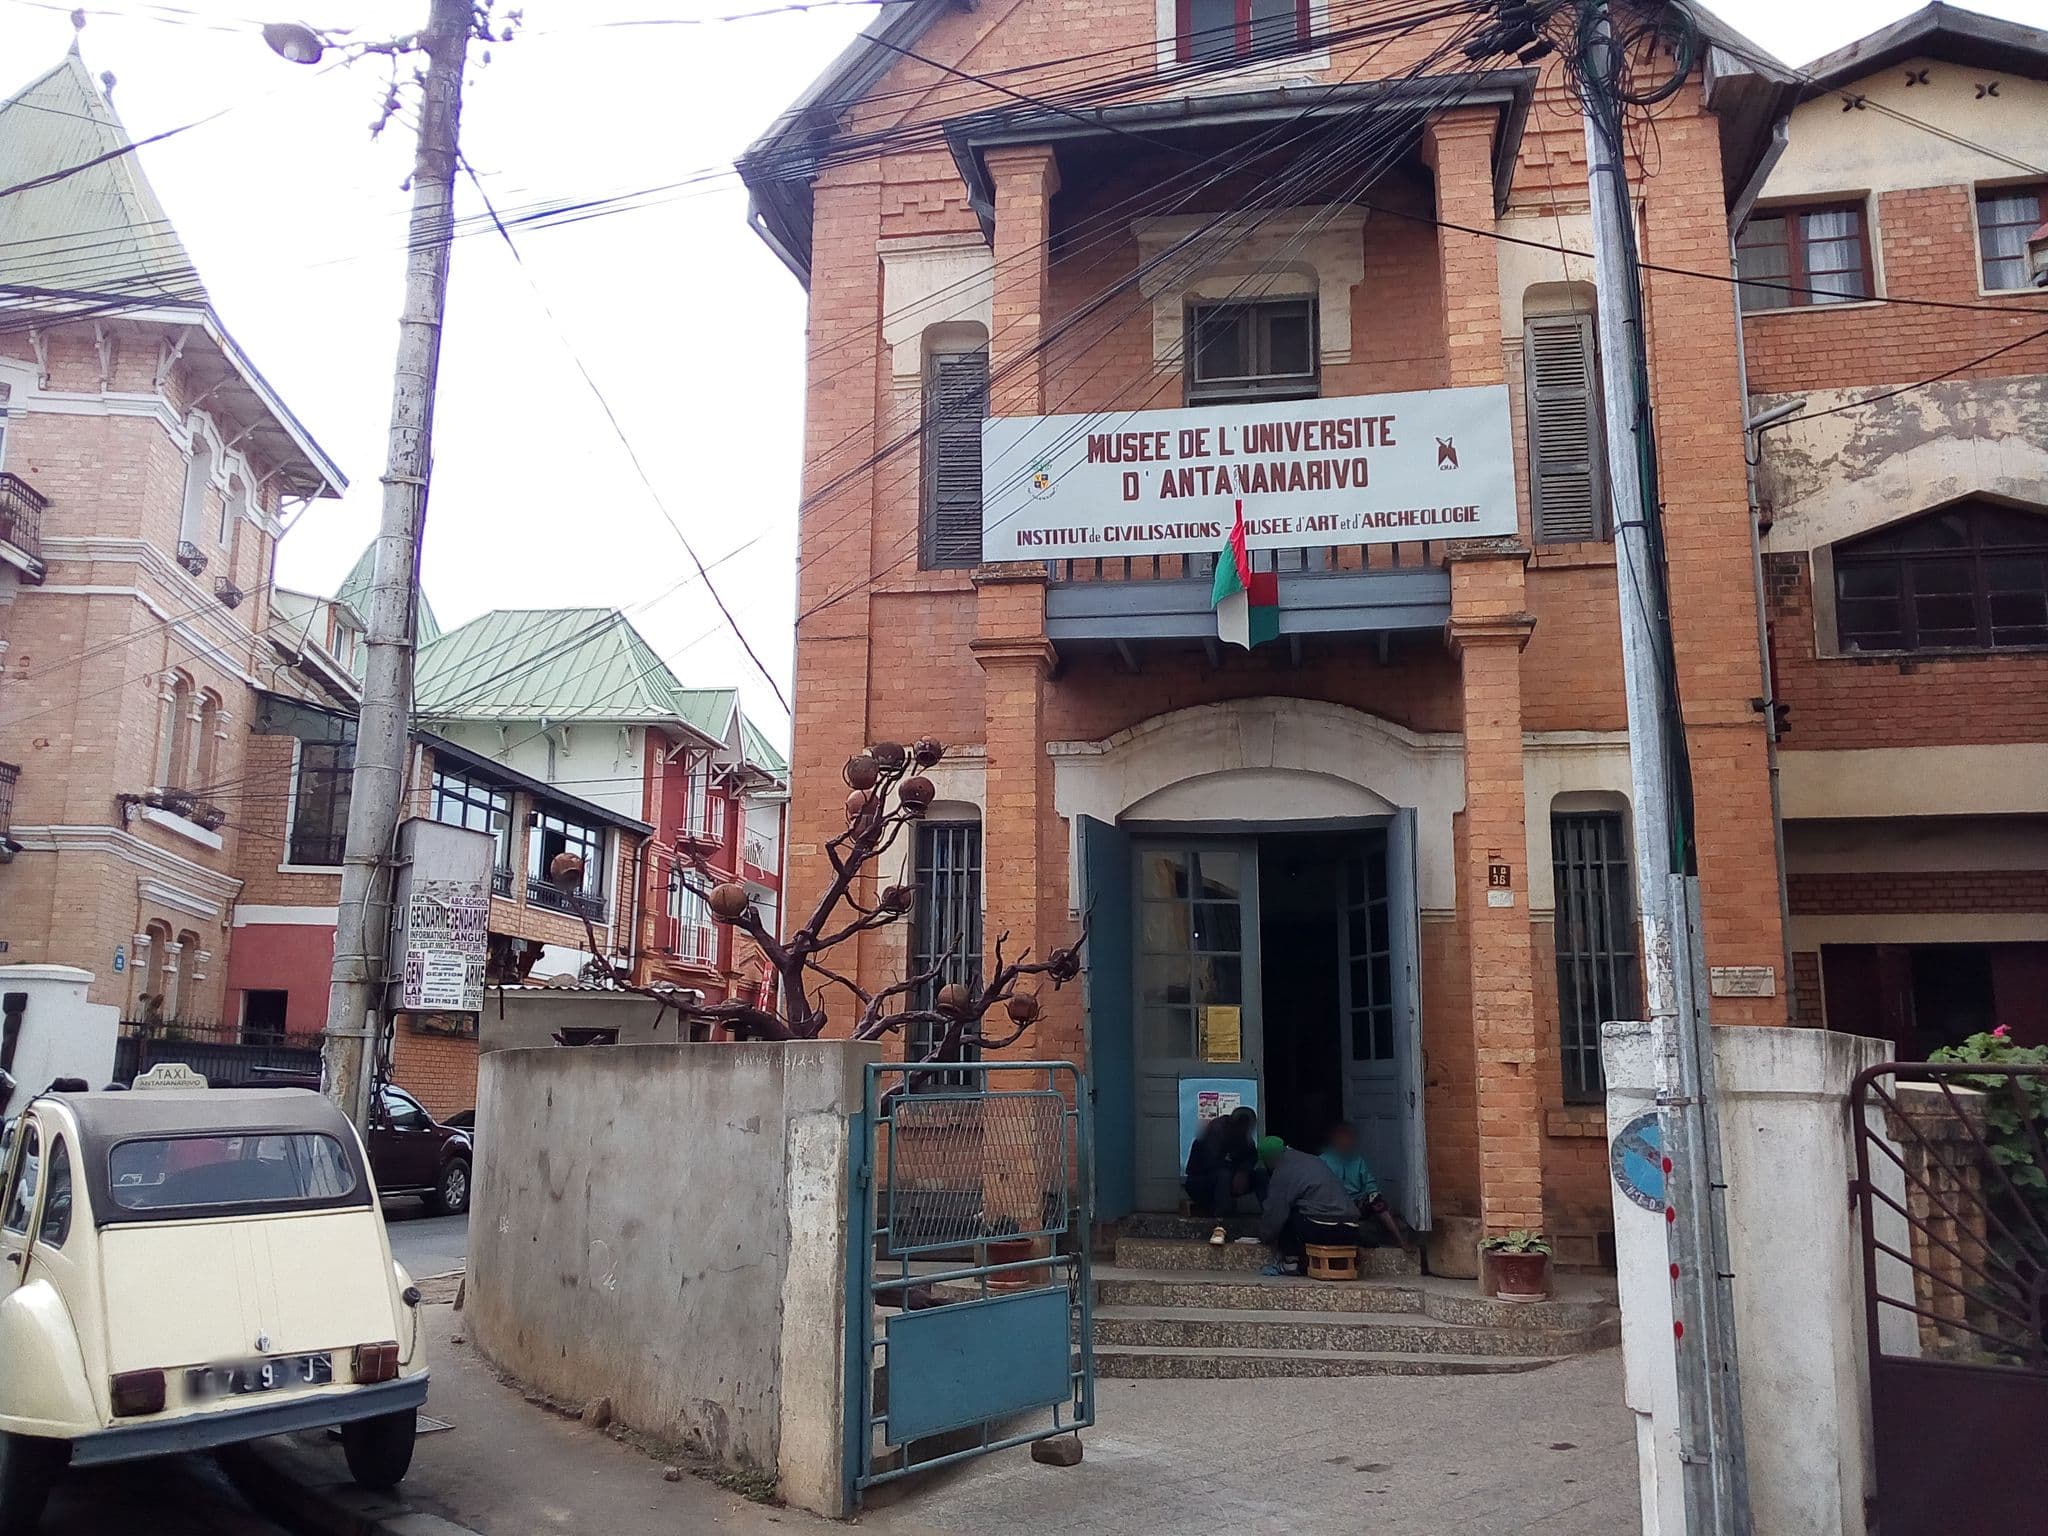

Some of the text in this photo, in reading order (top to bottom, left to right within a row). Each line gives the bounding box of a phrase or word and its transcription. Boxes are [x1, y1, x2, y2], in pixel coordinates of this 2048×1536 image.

[1087, 431, 1171, 464] MUSEE
[1178, 427, 1211, 459] DE
[1159, 457, 1369, 499] ANTANANARIVO
[1016, 527, 1089, 546] INSTITUT
[1089, 526, 1101, 543] de
[1103, 521, 1221, 542] CIVILISATIONS
[451, 898, 489, 907] ABC SCHOOL
[410, 931, 450, 940] INFORMATIQUE
[156, 1068, 186, 1079] TAXI
[140, 1079, 201, 1087] ANTANANARIVO
